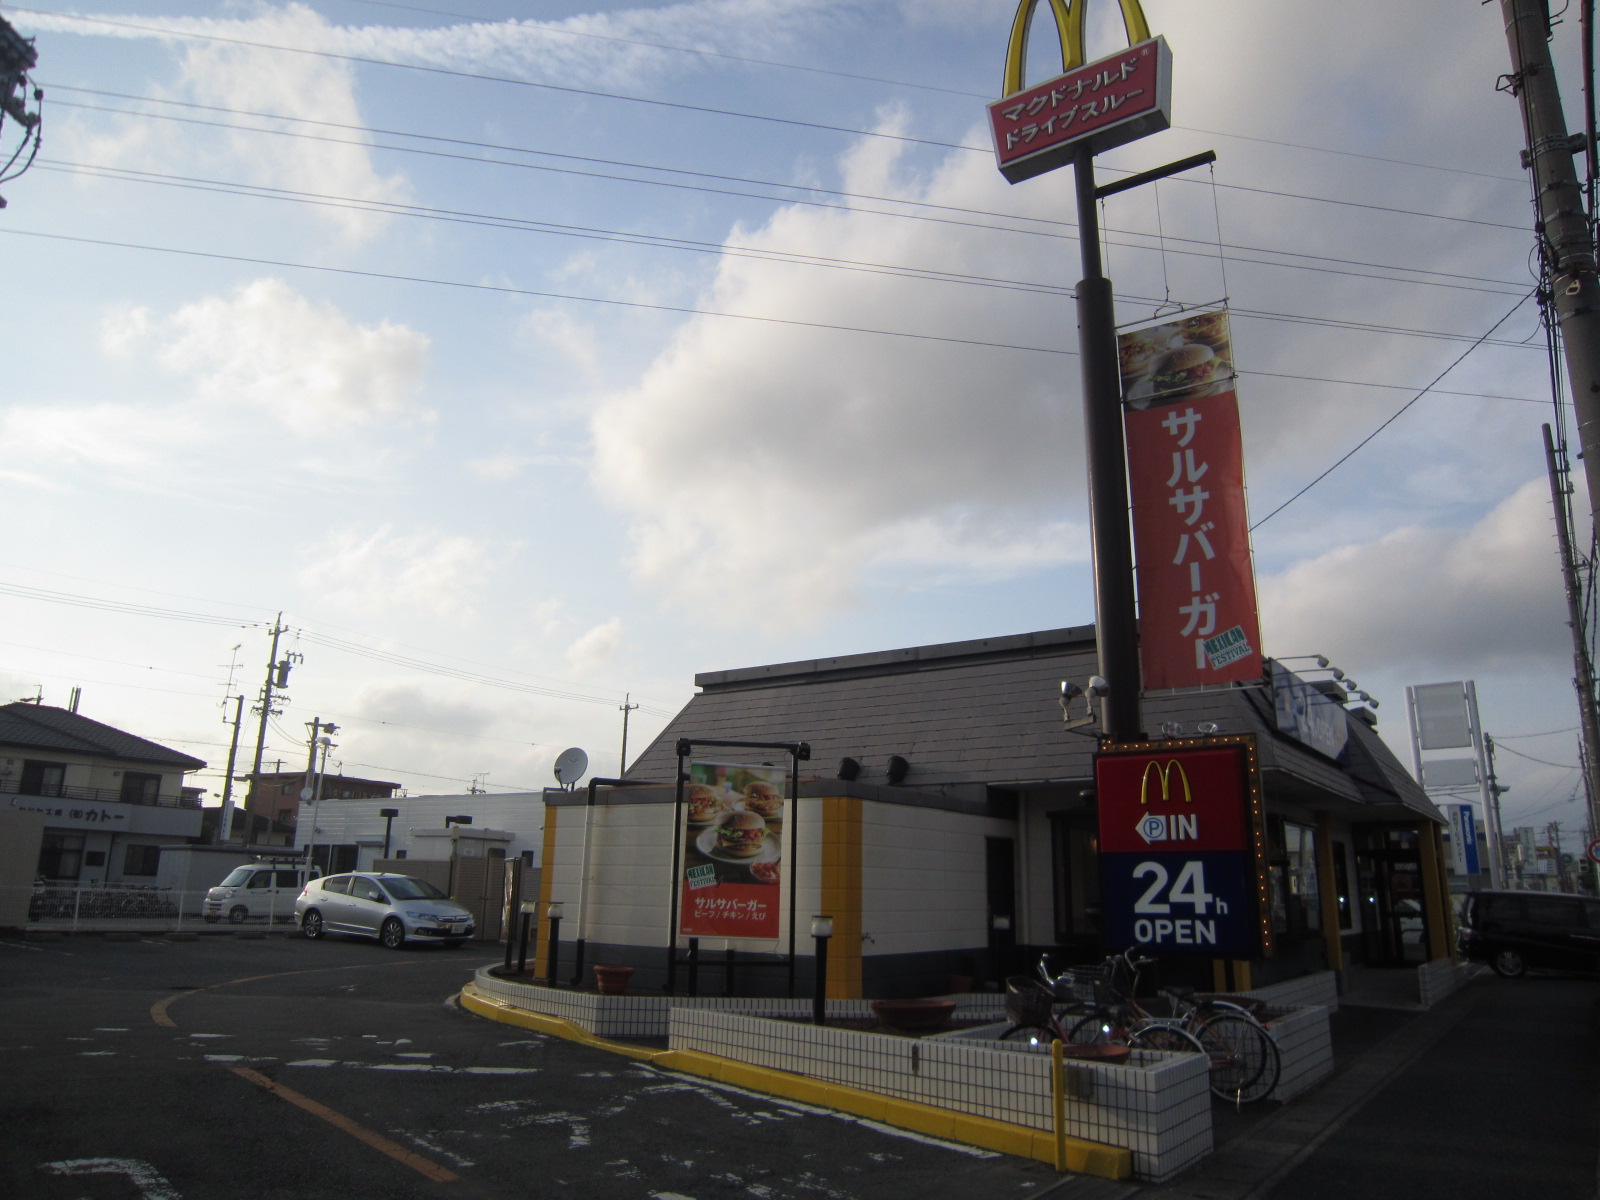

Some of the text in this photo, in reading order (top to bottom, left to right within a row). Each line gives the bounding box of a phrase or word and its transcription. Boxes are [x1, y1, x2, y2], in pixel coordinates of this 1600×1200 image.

[1001, 56, 1139, 122] マクドナルド
[1005, 88, 1144, 150] ドライブスルー
[1161, 407, 1220, 670] サルサバーガー
[1211, 644, 1250, 667] FESTIVAL
[1169, 813, 1198, 841] IN
[694, 897, 767, 912] サルサバーガー
[1134, 919, 1216, 945] OPEN
